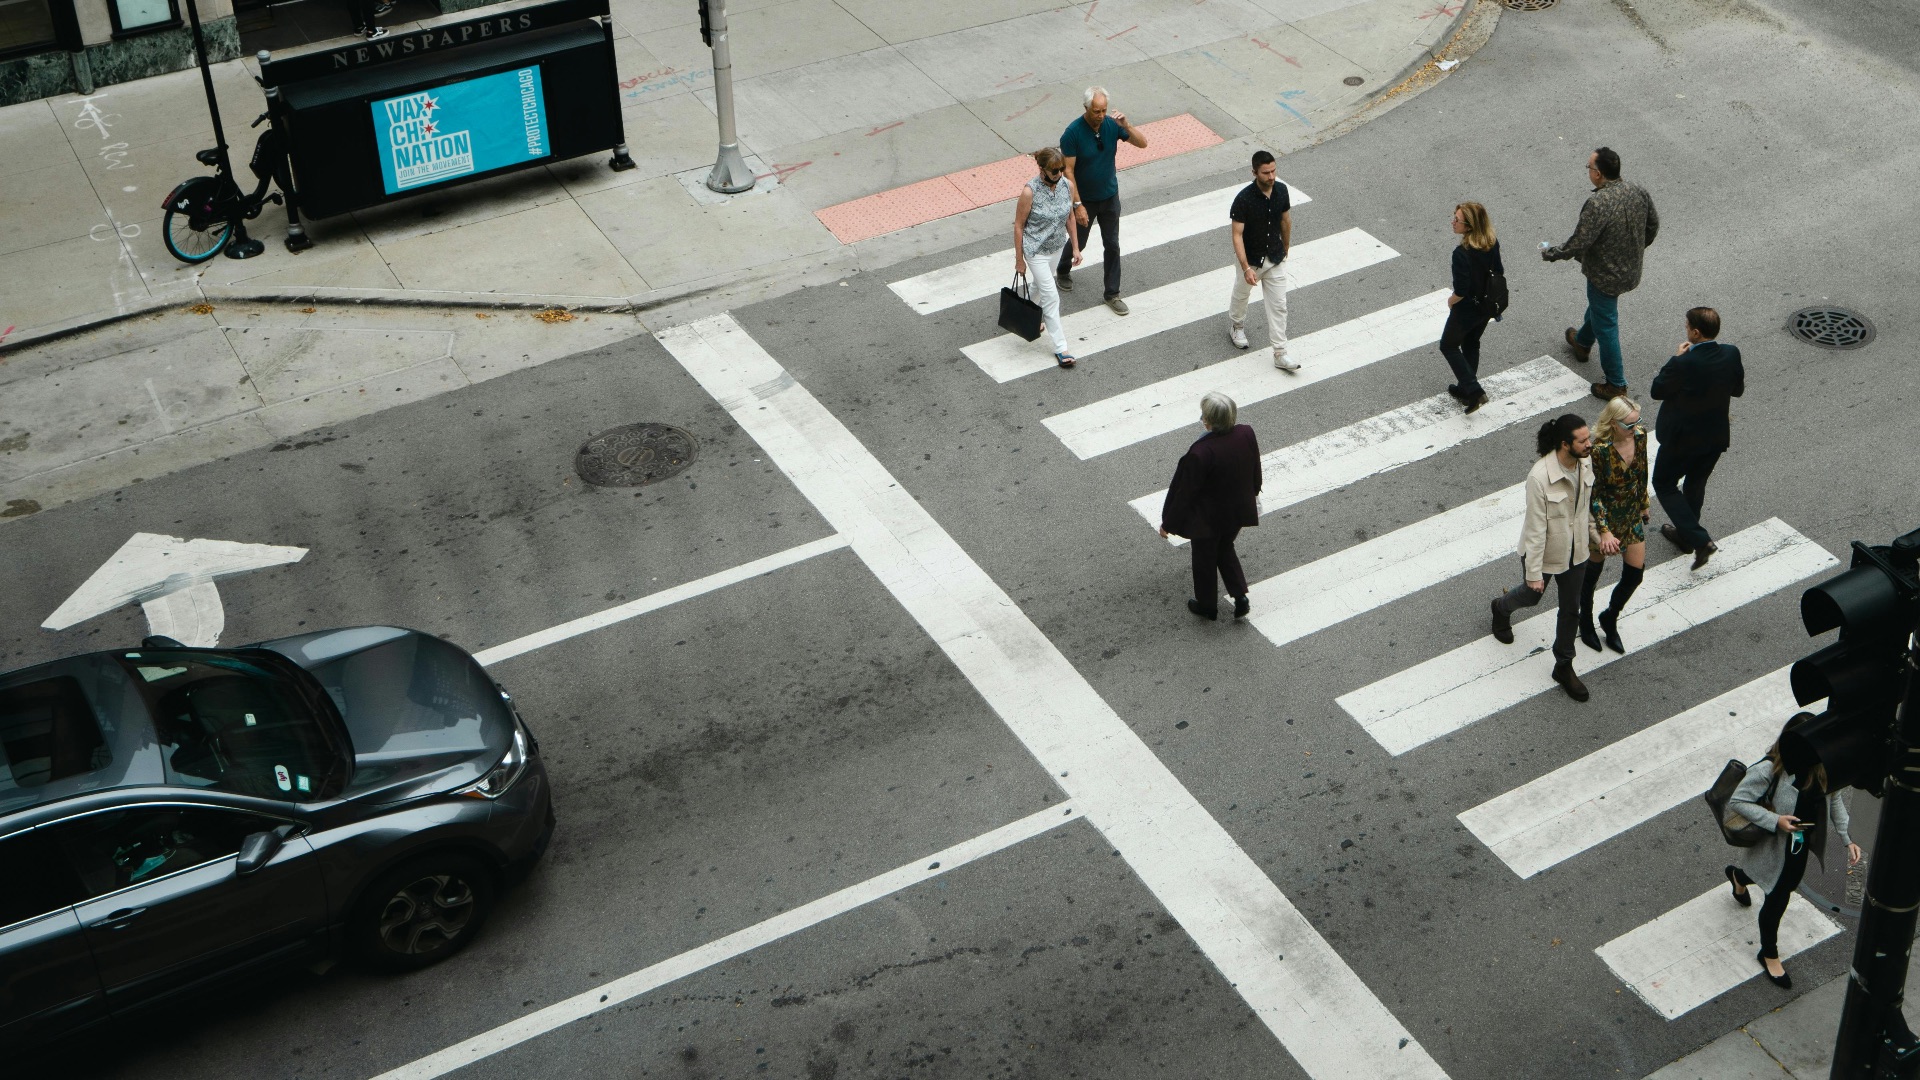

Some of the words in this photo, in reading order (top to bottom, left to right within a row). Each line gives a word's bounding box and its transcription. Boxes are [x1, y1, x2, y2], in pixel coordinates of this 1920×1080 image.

[333, 13, 531, 69] NEWSPAPERS
[387, 96, 428, 123] VAX
[518, 69, 542, 155] #PROTECTCHICAGO
[395, 133, 470, 170] NATION
[399, 168, 415, 179] JOIN
[417, 165, 430, 175] THE
[432, 154, 470, 170] MOVEMENT
